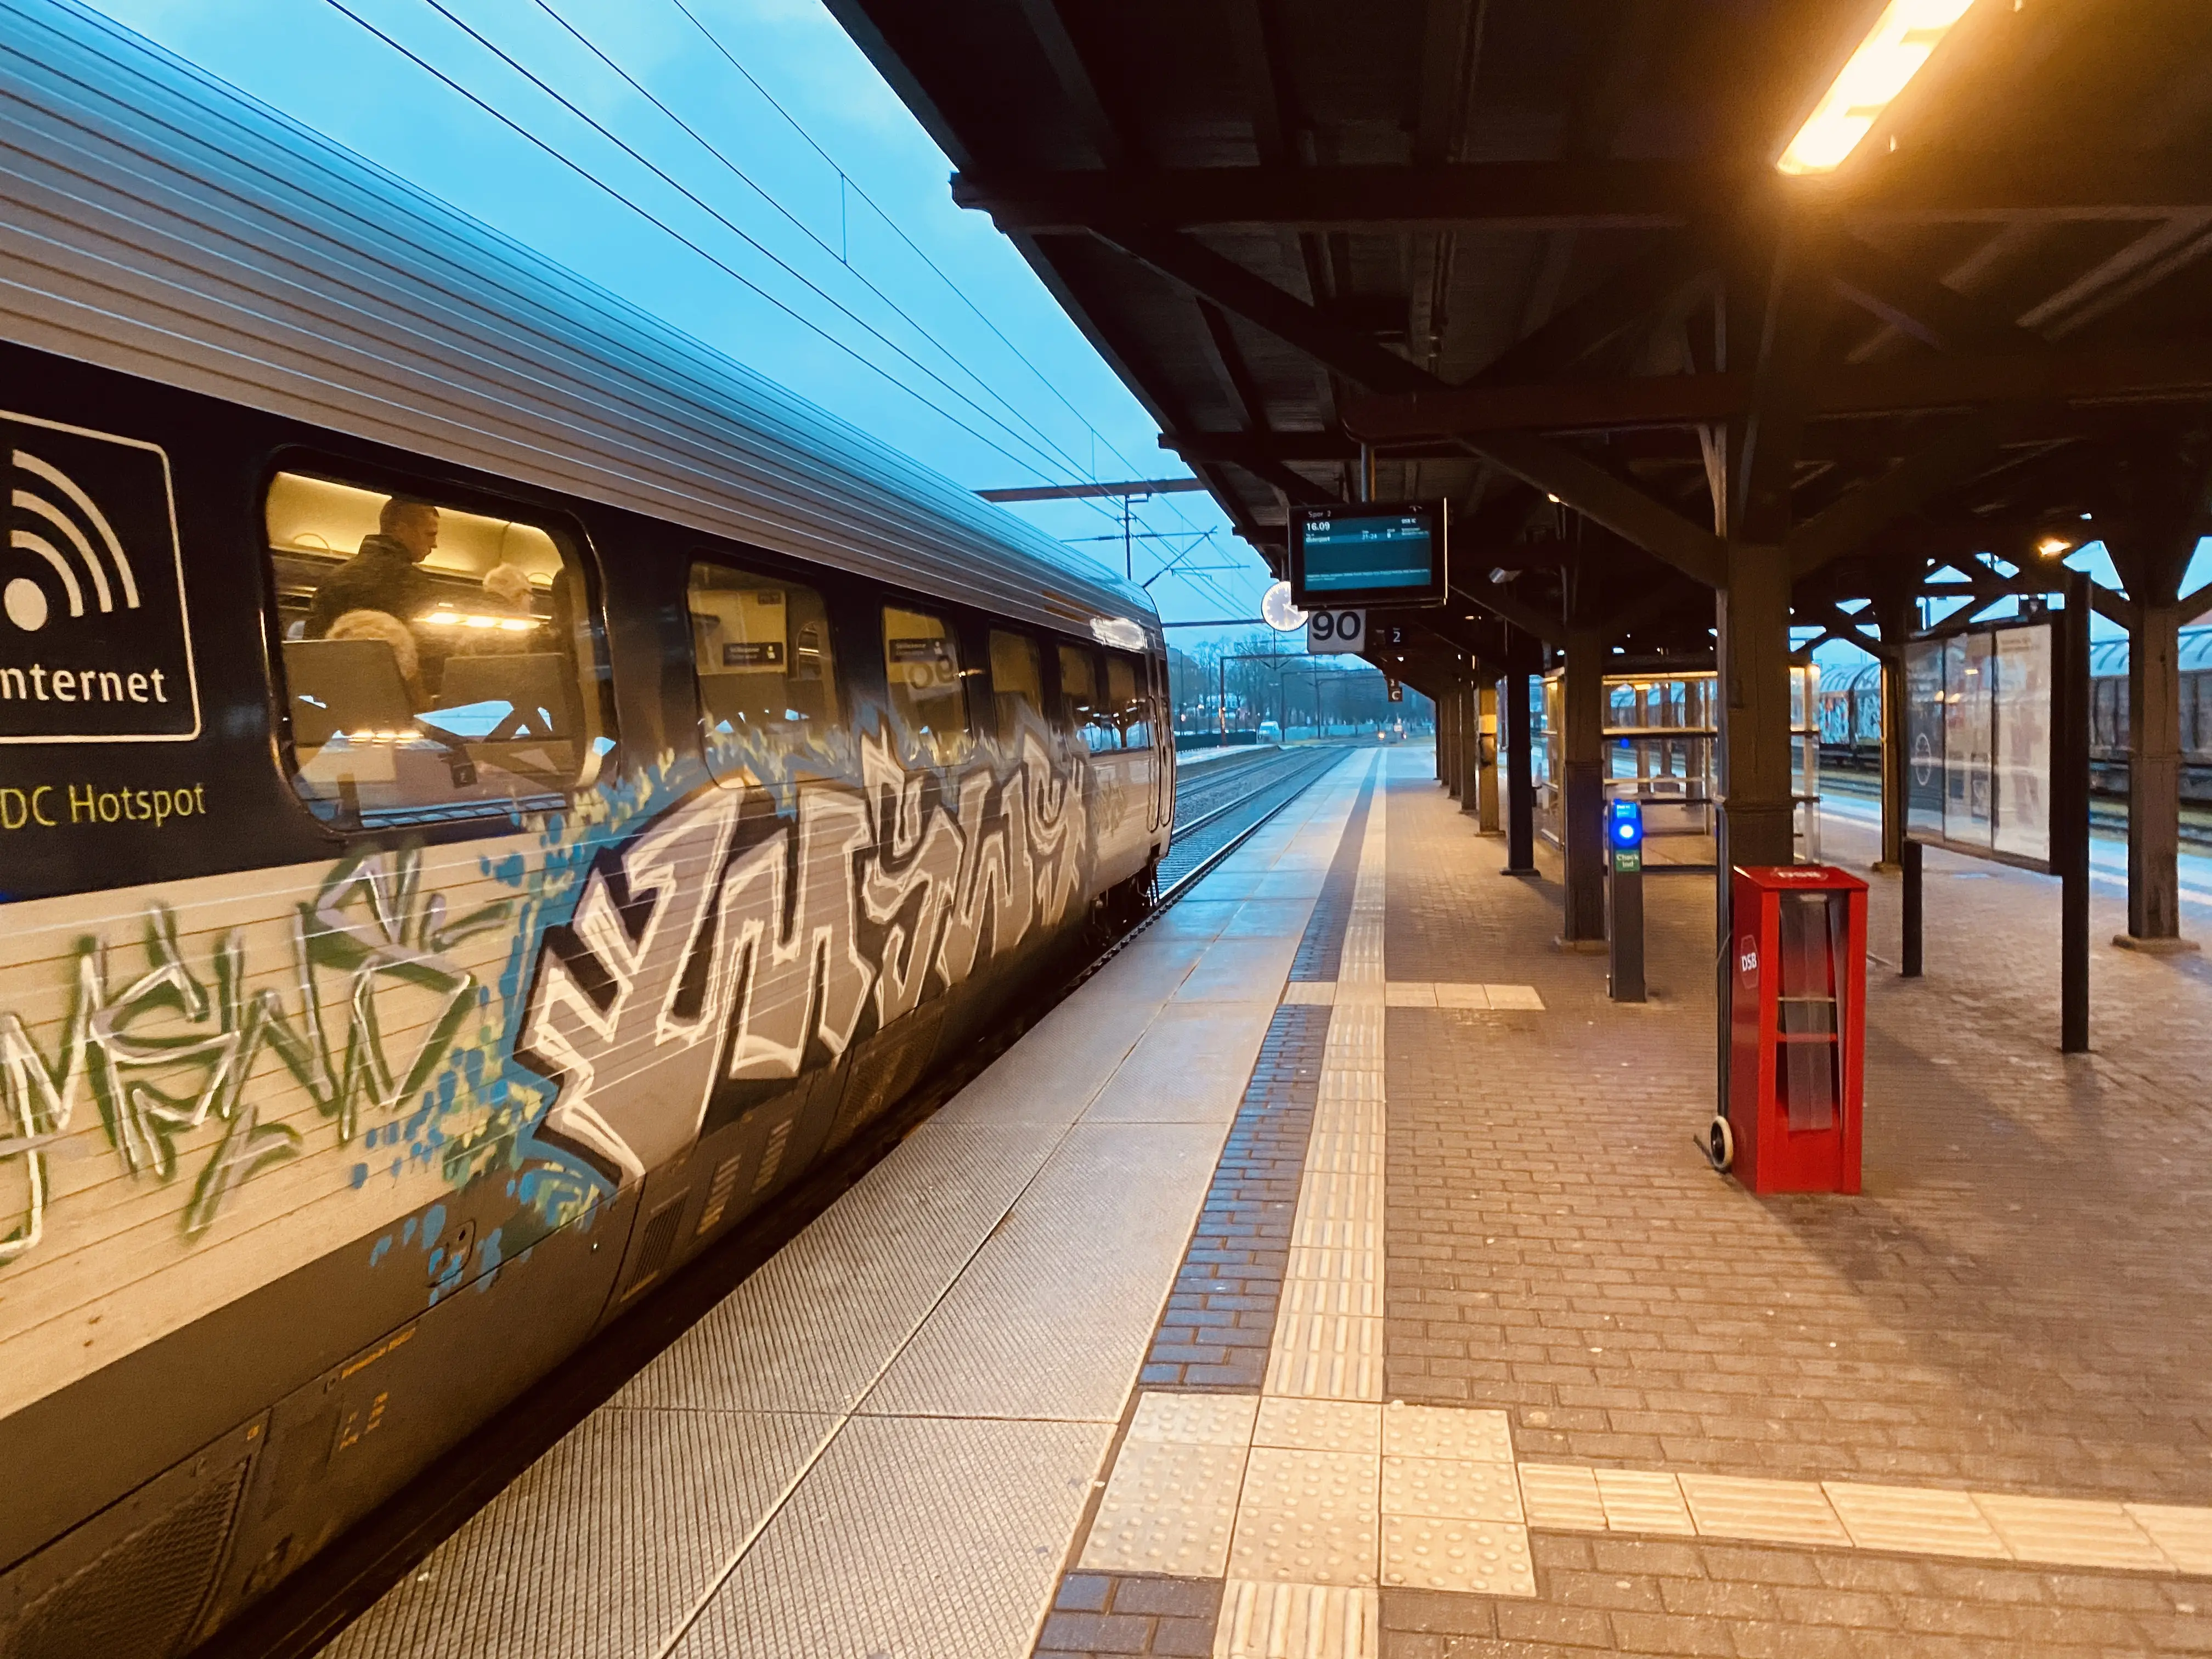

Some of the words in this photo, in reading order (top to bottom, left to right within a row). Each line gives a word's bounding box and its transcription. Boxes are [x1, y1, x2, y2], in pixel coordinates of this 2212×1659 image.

[1306, 522, 1330, 531] 16.09
[1312, 611, 1361, 640] 90
[1393, 631, 1400, 642] 2
[0, 663, 167, 703] nternet
[0, 786, 56, 829] DC
[69, 783, 205, 827] Hotspot
[1741, 952, 1757, 972] DSB
